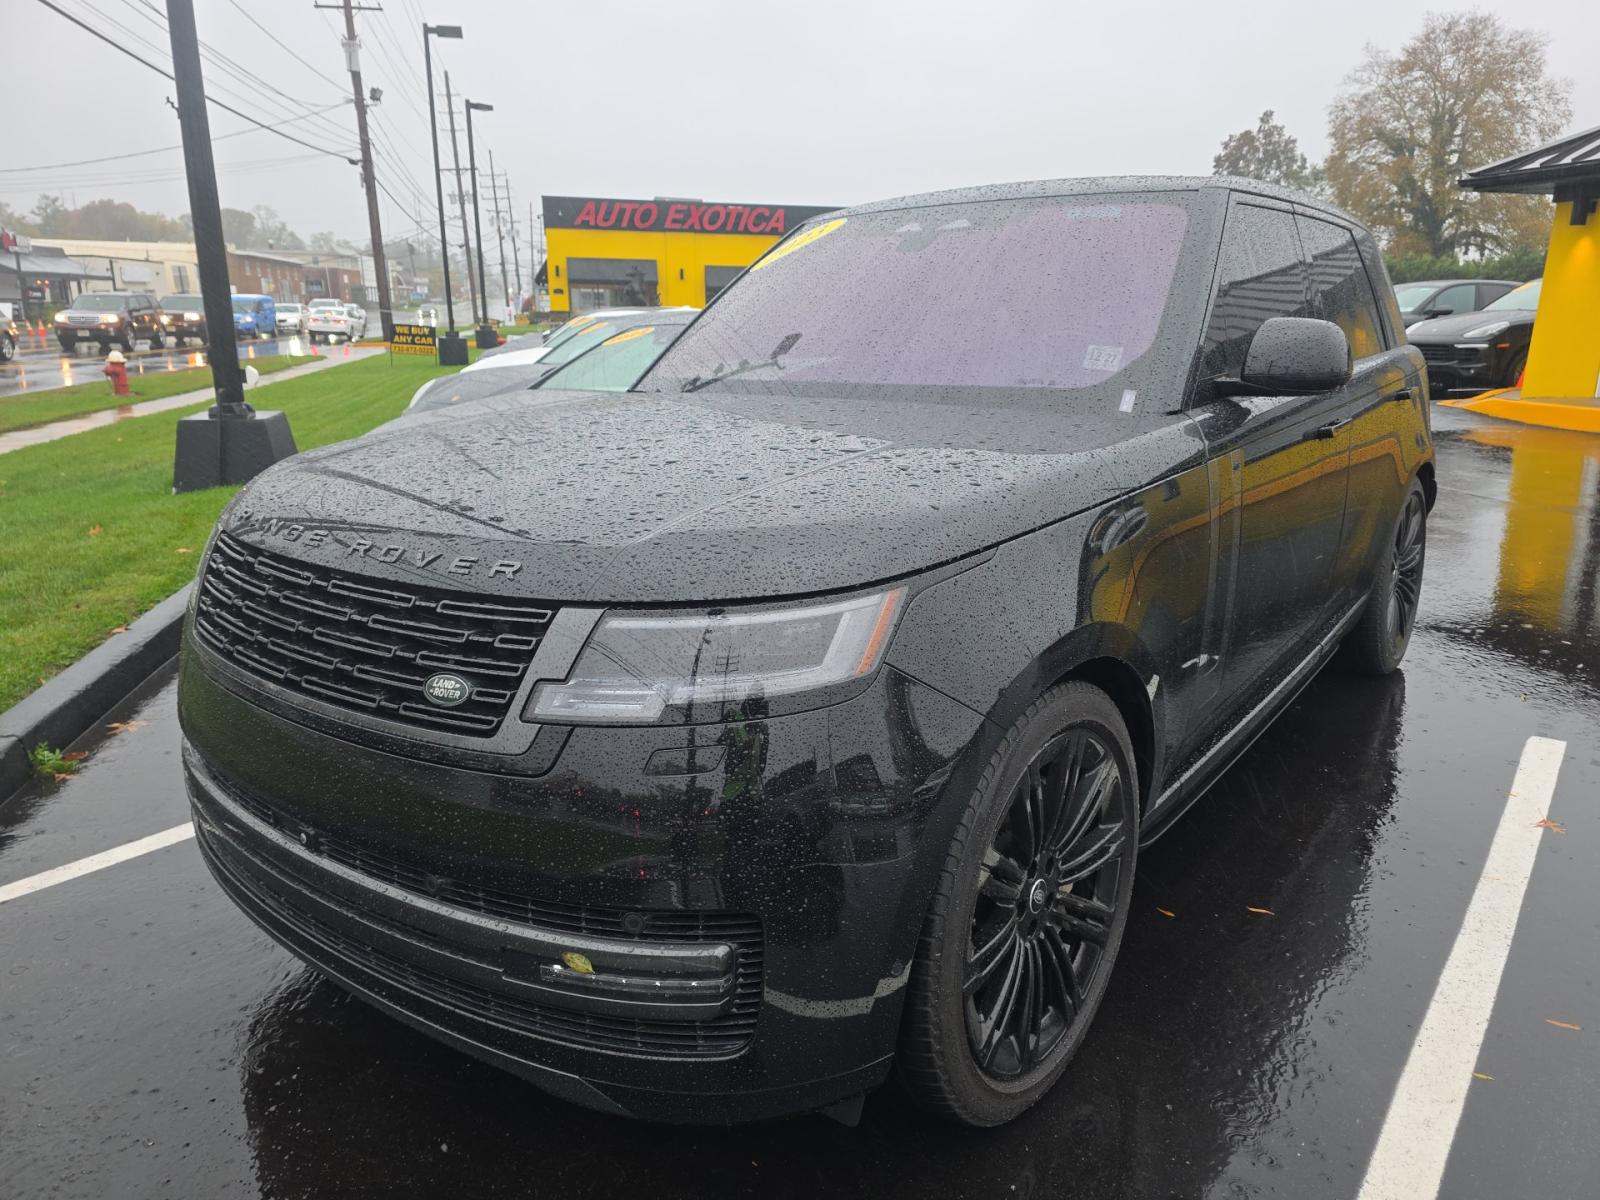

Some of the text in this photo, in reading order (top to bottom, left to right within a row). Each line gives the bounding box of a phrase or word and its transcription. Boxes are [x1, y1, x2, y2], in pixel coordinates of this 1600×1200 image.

[575, 201, 786, 232] AUTO EXOTICA
[395, 325, 429, 335] WE BUY
[393, 335, 432, 344] ANY CAR
[348, 539, 523, 580] ROVER
[433, 678, 455, 689] LAND
[433, 688, 461, 699] ROVER
